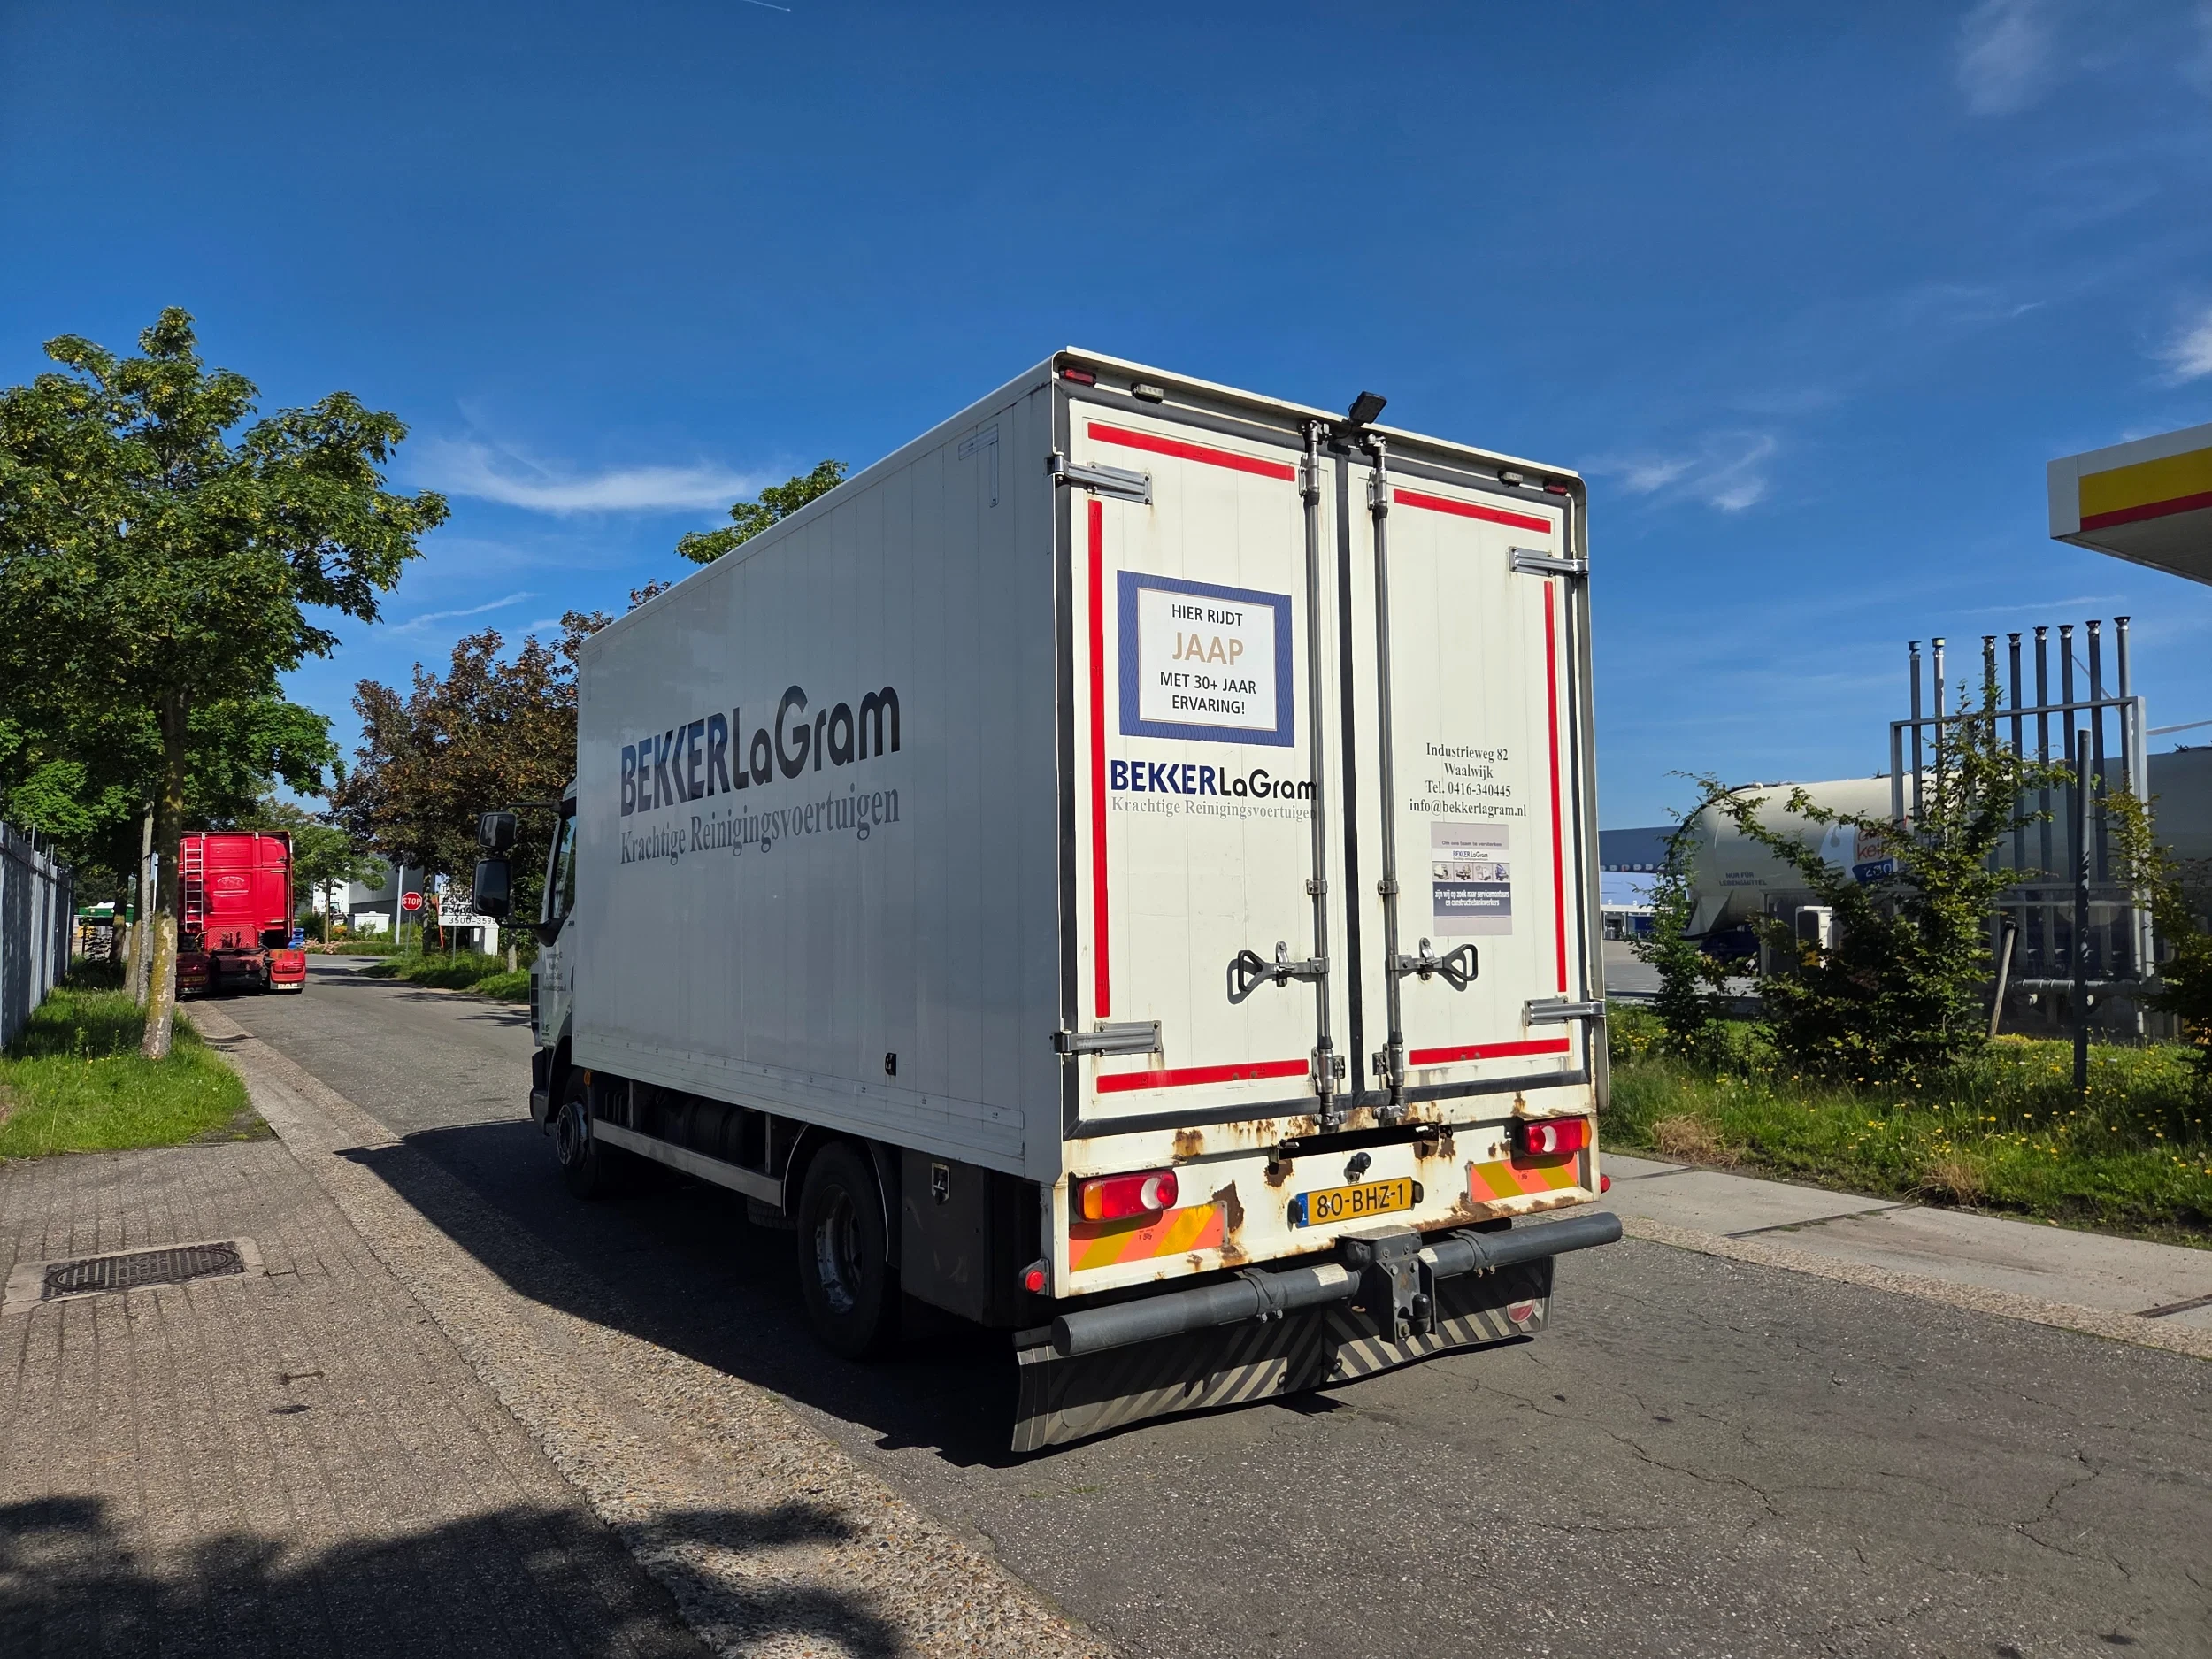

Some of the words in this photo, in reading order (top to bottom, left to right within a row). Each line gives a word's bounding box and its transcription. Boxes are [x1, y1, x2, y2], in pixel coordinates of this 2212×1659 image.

[1171, 604, 1203, 622] HIER
[1207, 610, 1243, 626] RIJDT
[1171, 631, 1244, 665] JAAP
[1160, 672, 1190, 687] MET
[1194, 675, 1218, 691] 30+
[1222, 678, 1256, 695] JAAR
[1171, 695, 1245, 715] ERVARING!
[1426, 742, 1494, 763] Industrieweg
[1496, 749, 1509, 761] 82
[1444, 763, 1494, 780] Waalwijk
[1425, 780, 1445, 794] Tel.
[1448, 781, 1511, 797] 0416-340445
[1111, 796, 1180, 818] Krachtige
[1185, 800, 1317, 822] Reinigingsvoertuigen
[1409, 798, 1527, 818] info@bekkerlagram.nl
[620, 822, 686, 866] Krachtige
[690, 782, 900, 856] Reinigingsvoertuigen
[1317, 1183, 1404, 1218] 80-BHZ-1
